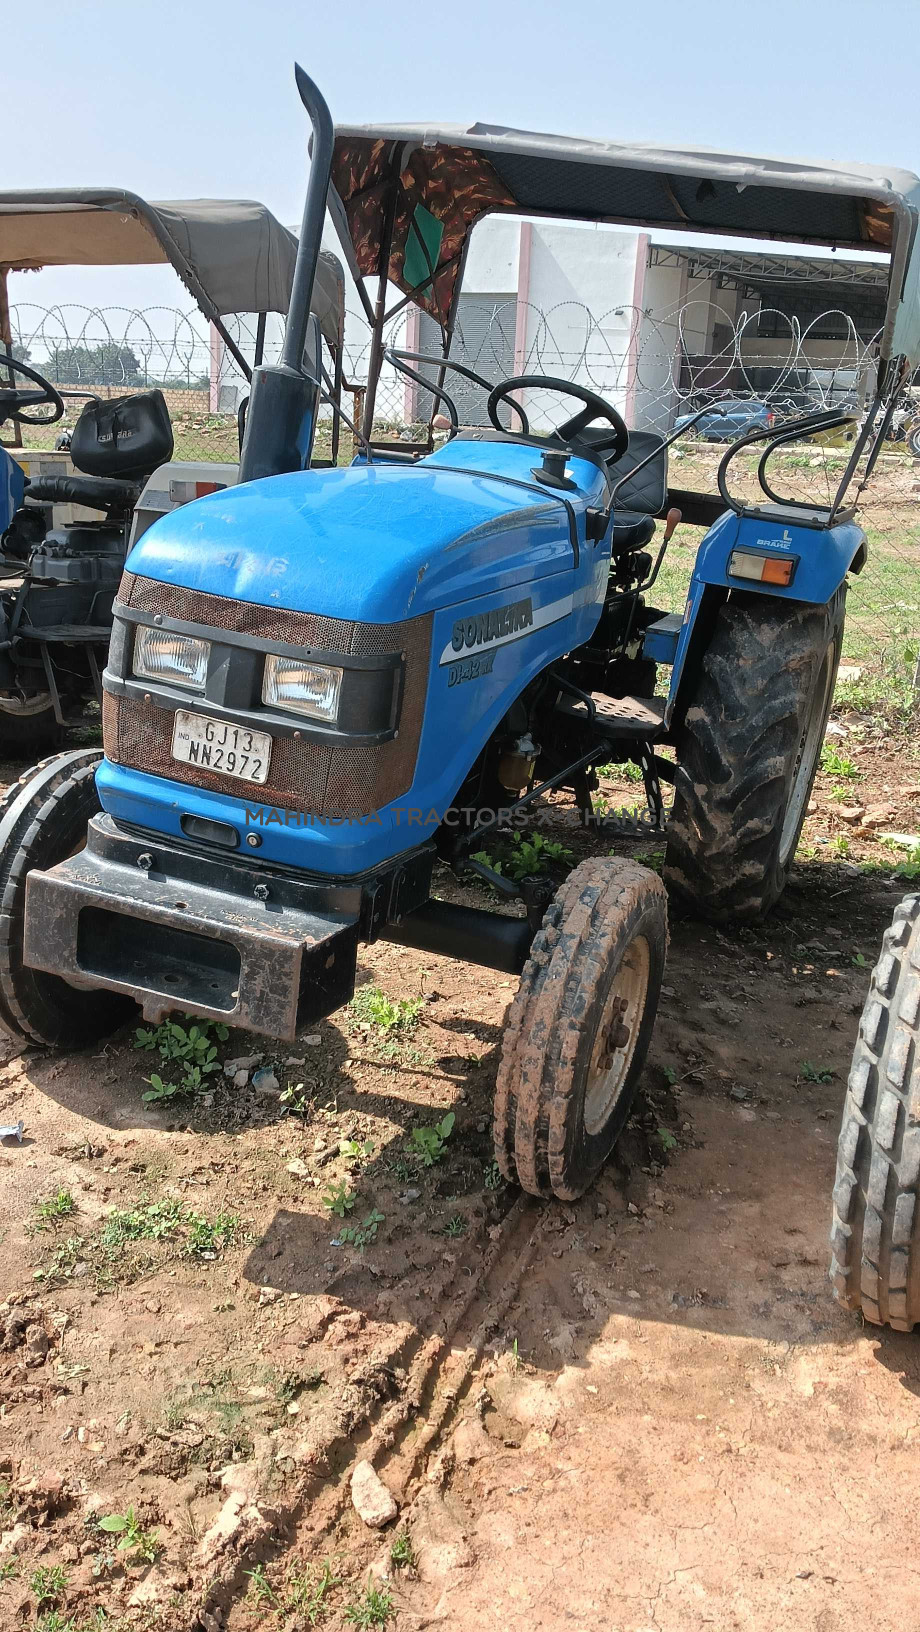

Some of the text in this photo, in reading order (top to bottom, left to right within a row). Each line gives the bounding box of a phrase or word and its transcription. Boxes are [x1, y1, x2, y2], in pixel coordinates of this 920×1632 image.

[757, 538, 792, 550] BRAKE
[177, 732, 190, 741] IND
[205, 721, 254, 752] GJ13
[188, 740, 262, 780] NN2972
